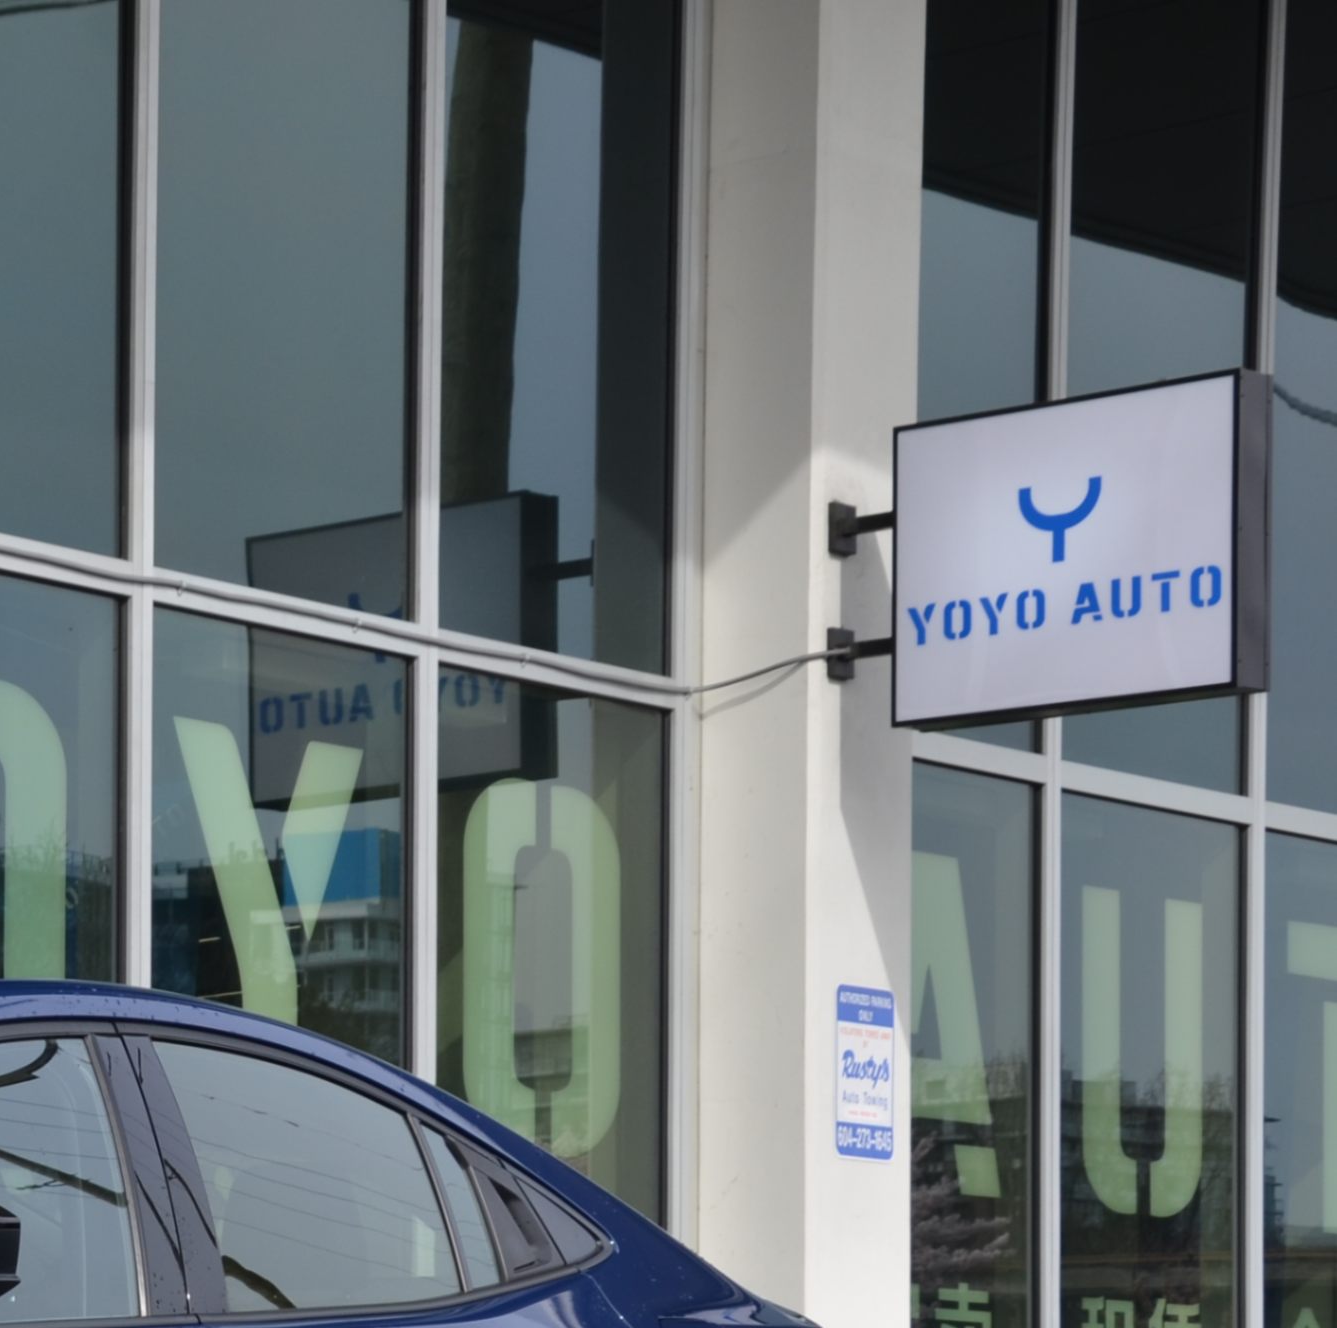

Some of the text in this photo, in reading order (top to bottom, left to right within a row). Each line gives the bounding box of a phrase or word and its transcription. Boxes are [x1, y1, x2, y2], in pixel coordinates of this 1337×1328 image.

[908, 564, 1223, 646] YOYO AUTO
[842, 1048, 890, 1089] Rusty's
